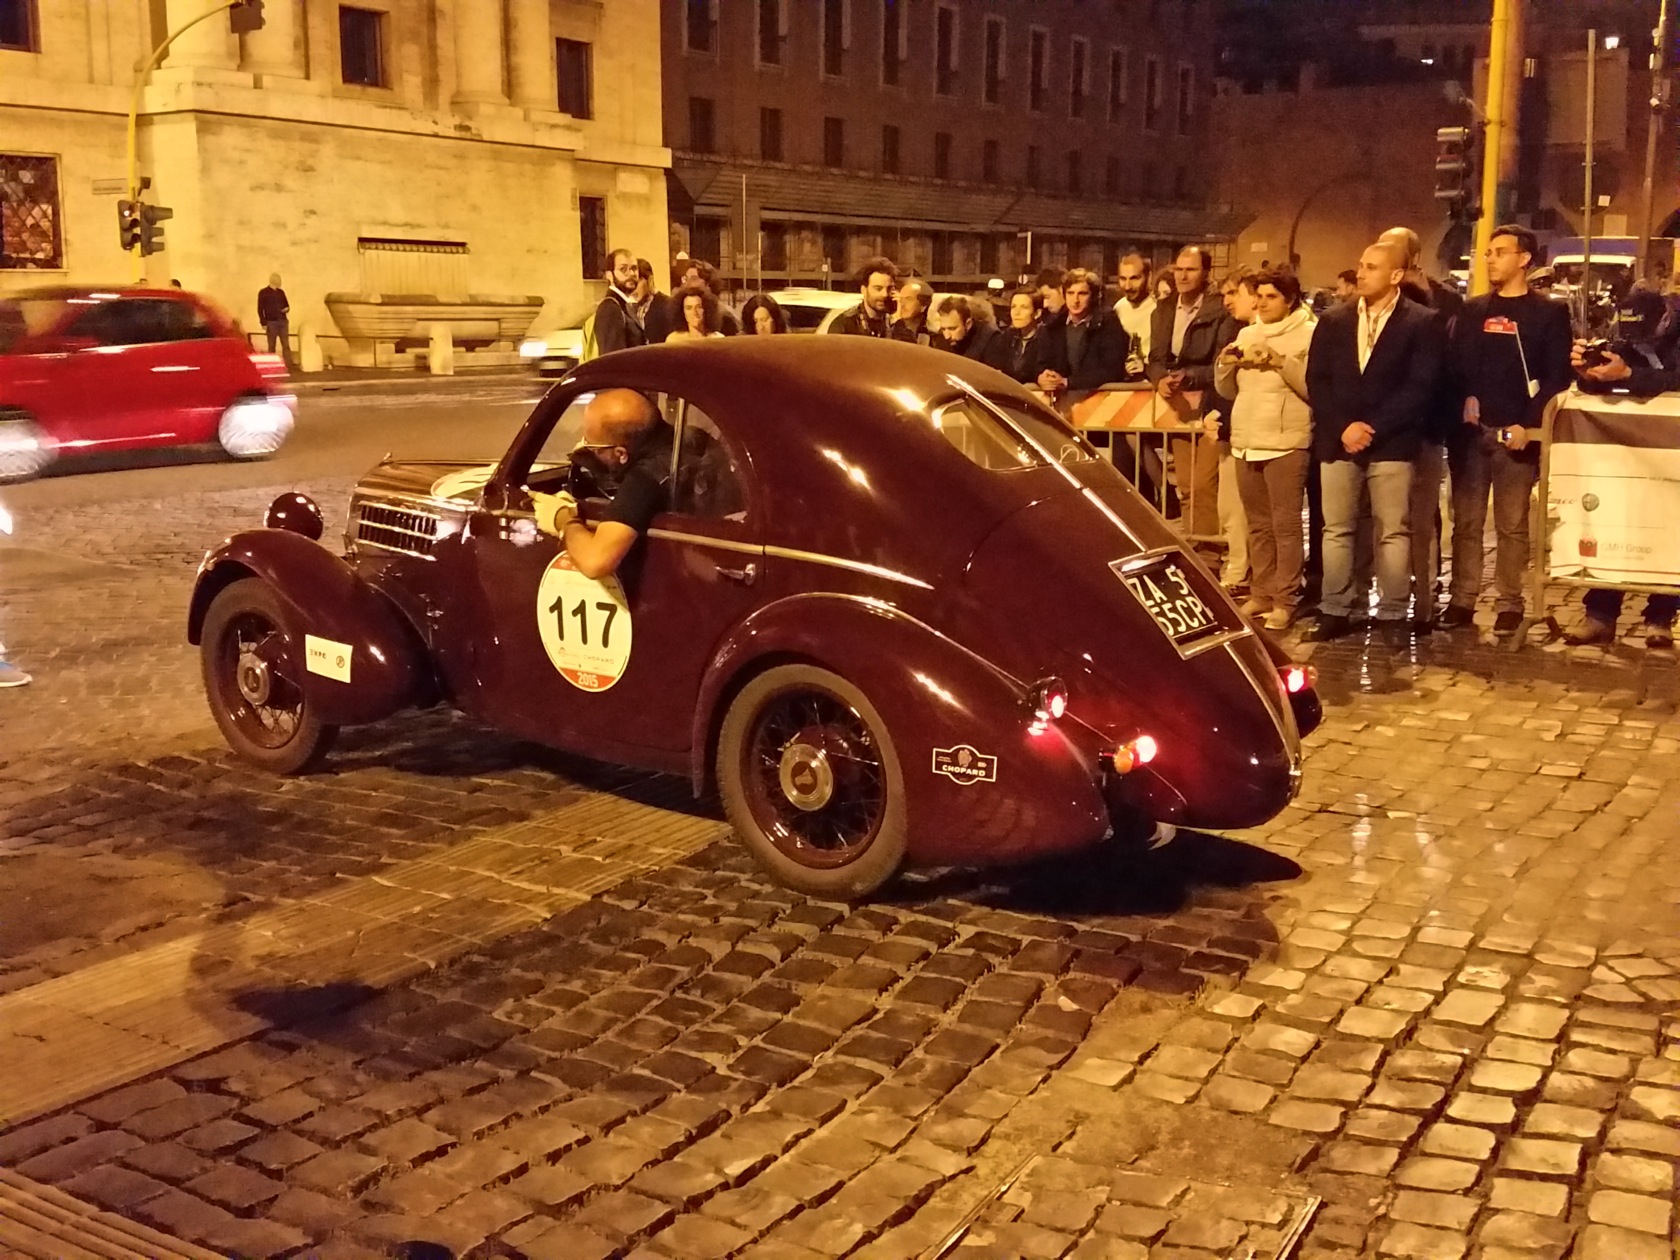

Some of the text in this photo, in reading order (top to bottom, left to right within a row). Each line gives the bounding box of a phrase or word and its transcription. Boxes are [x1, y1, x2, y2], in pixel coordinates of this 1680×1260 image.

[1626, 543, 1652, 554] Group
[1126, 566, 1189, 607] ZA 5
[549, 595, 618, 649] 117
[583, 654, 615, 665] CHOPARD
[577, 671, 599, 688] 2015
[942, 764, 986, 777] CHOPARD
